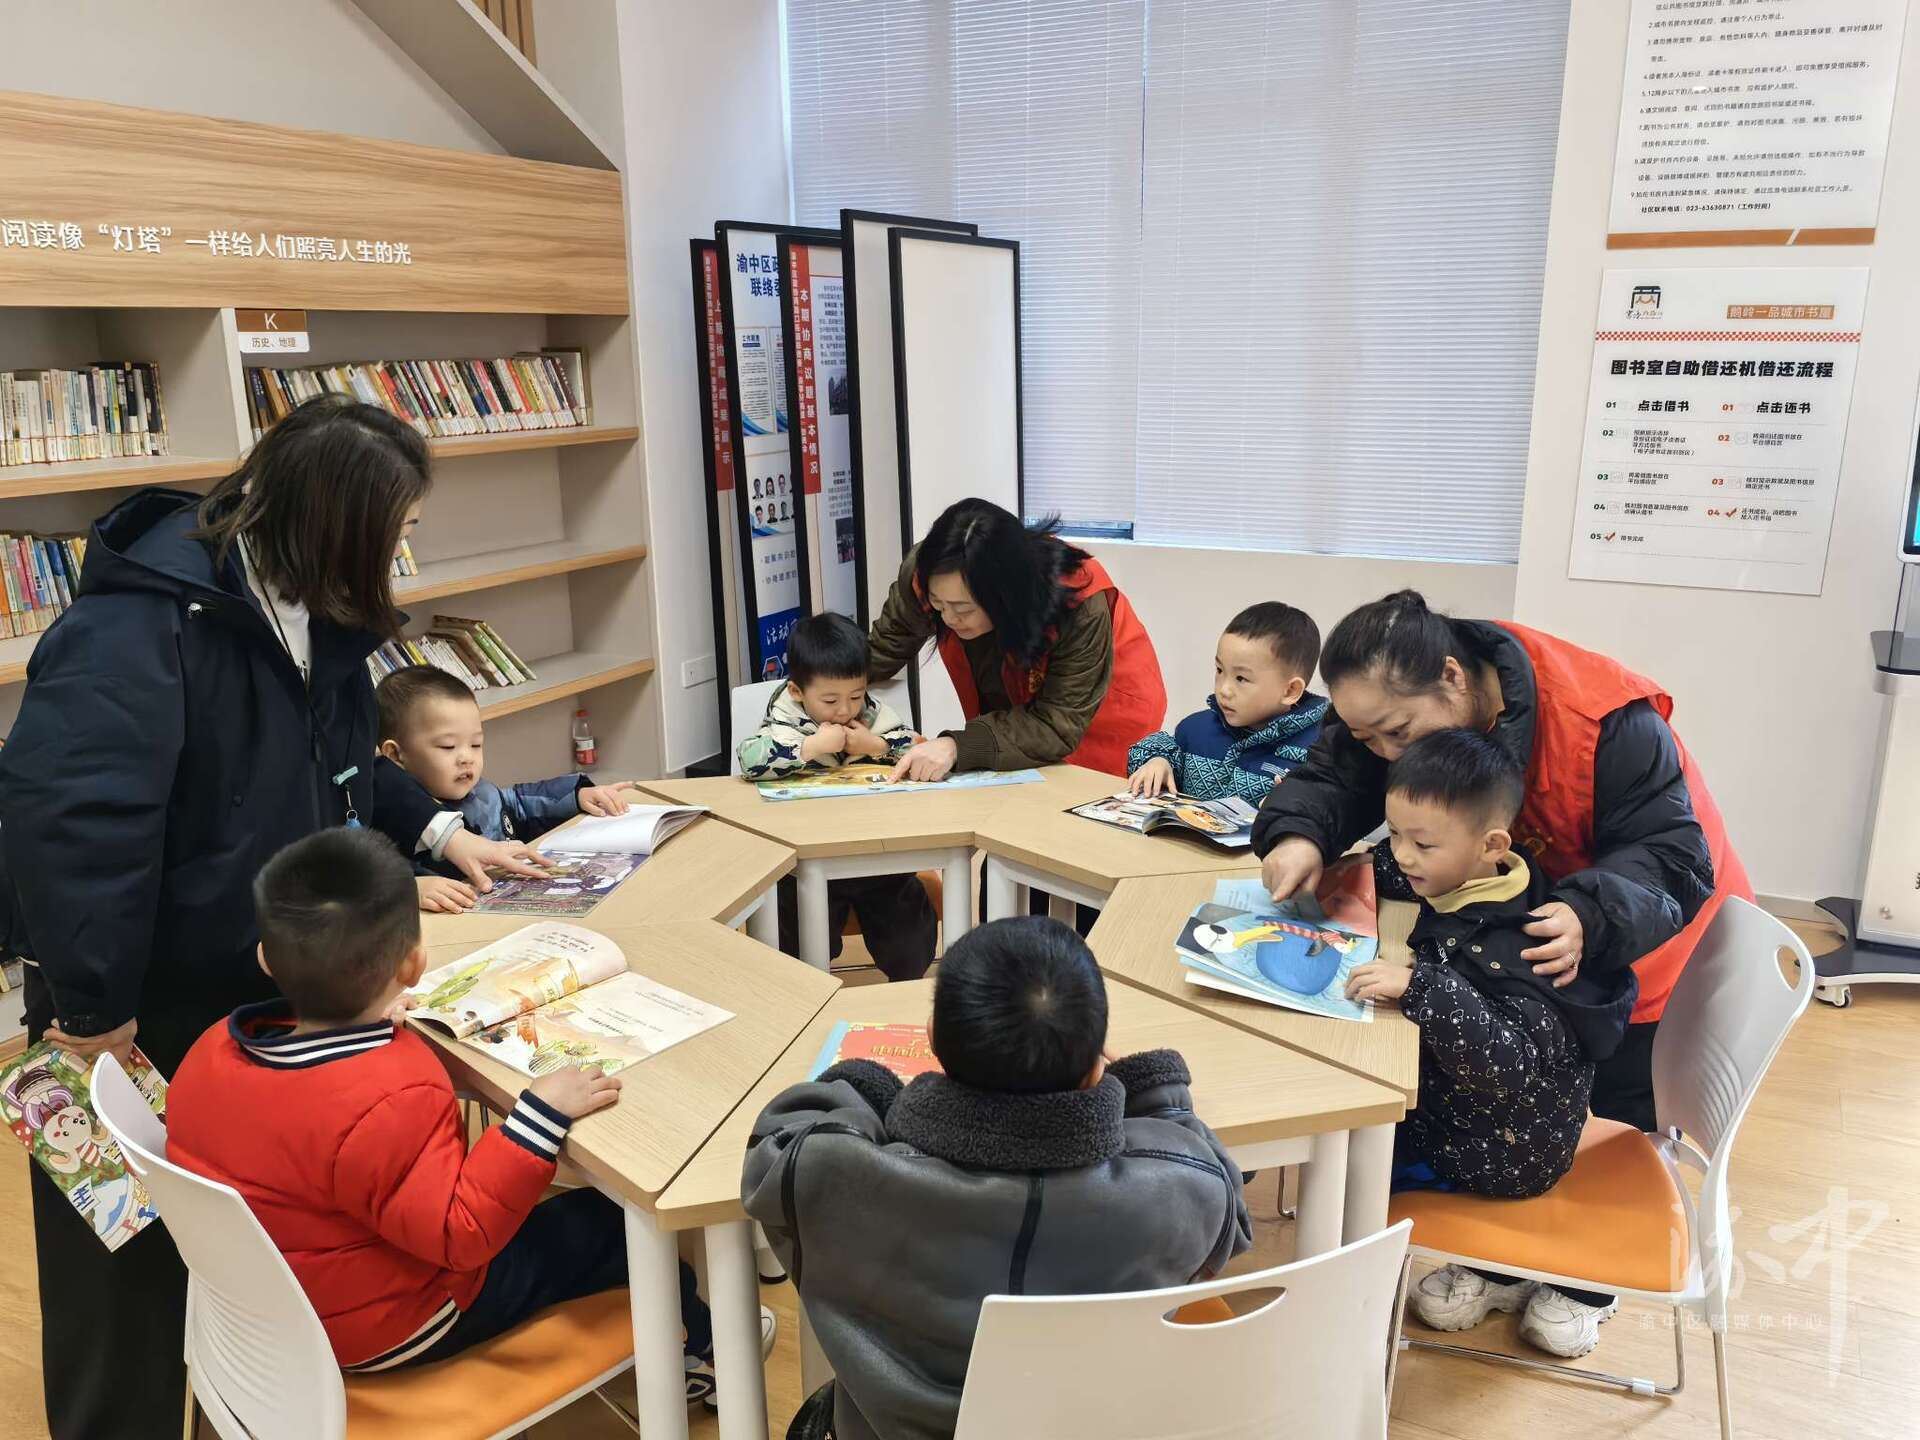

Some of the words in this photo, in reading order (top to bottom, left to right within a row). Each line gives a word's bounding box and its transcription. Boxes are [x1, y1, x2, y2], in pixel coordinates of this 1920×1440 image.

[264, 312, 278, 330] K
[252, 337, 296, 348] 历史、地理
[1610, 359, 1835, 378] 图书室自助借还机借还流程
[1637, 400, 1690, 413] 点击借书
[1722, 403, 1735, 412] 01
[1756, 400, 1811, 414] 点击还书
[1602, 429, 1614, 437] 02
[1718, 434, 1730, 442] 02
[1597, 473, 1609, 481] 03
[1711, 478, 1724, 486] 03
[1593, 503, 1606, 511] 04
[1707, 508, 1720, 517] 04
